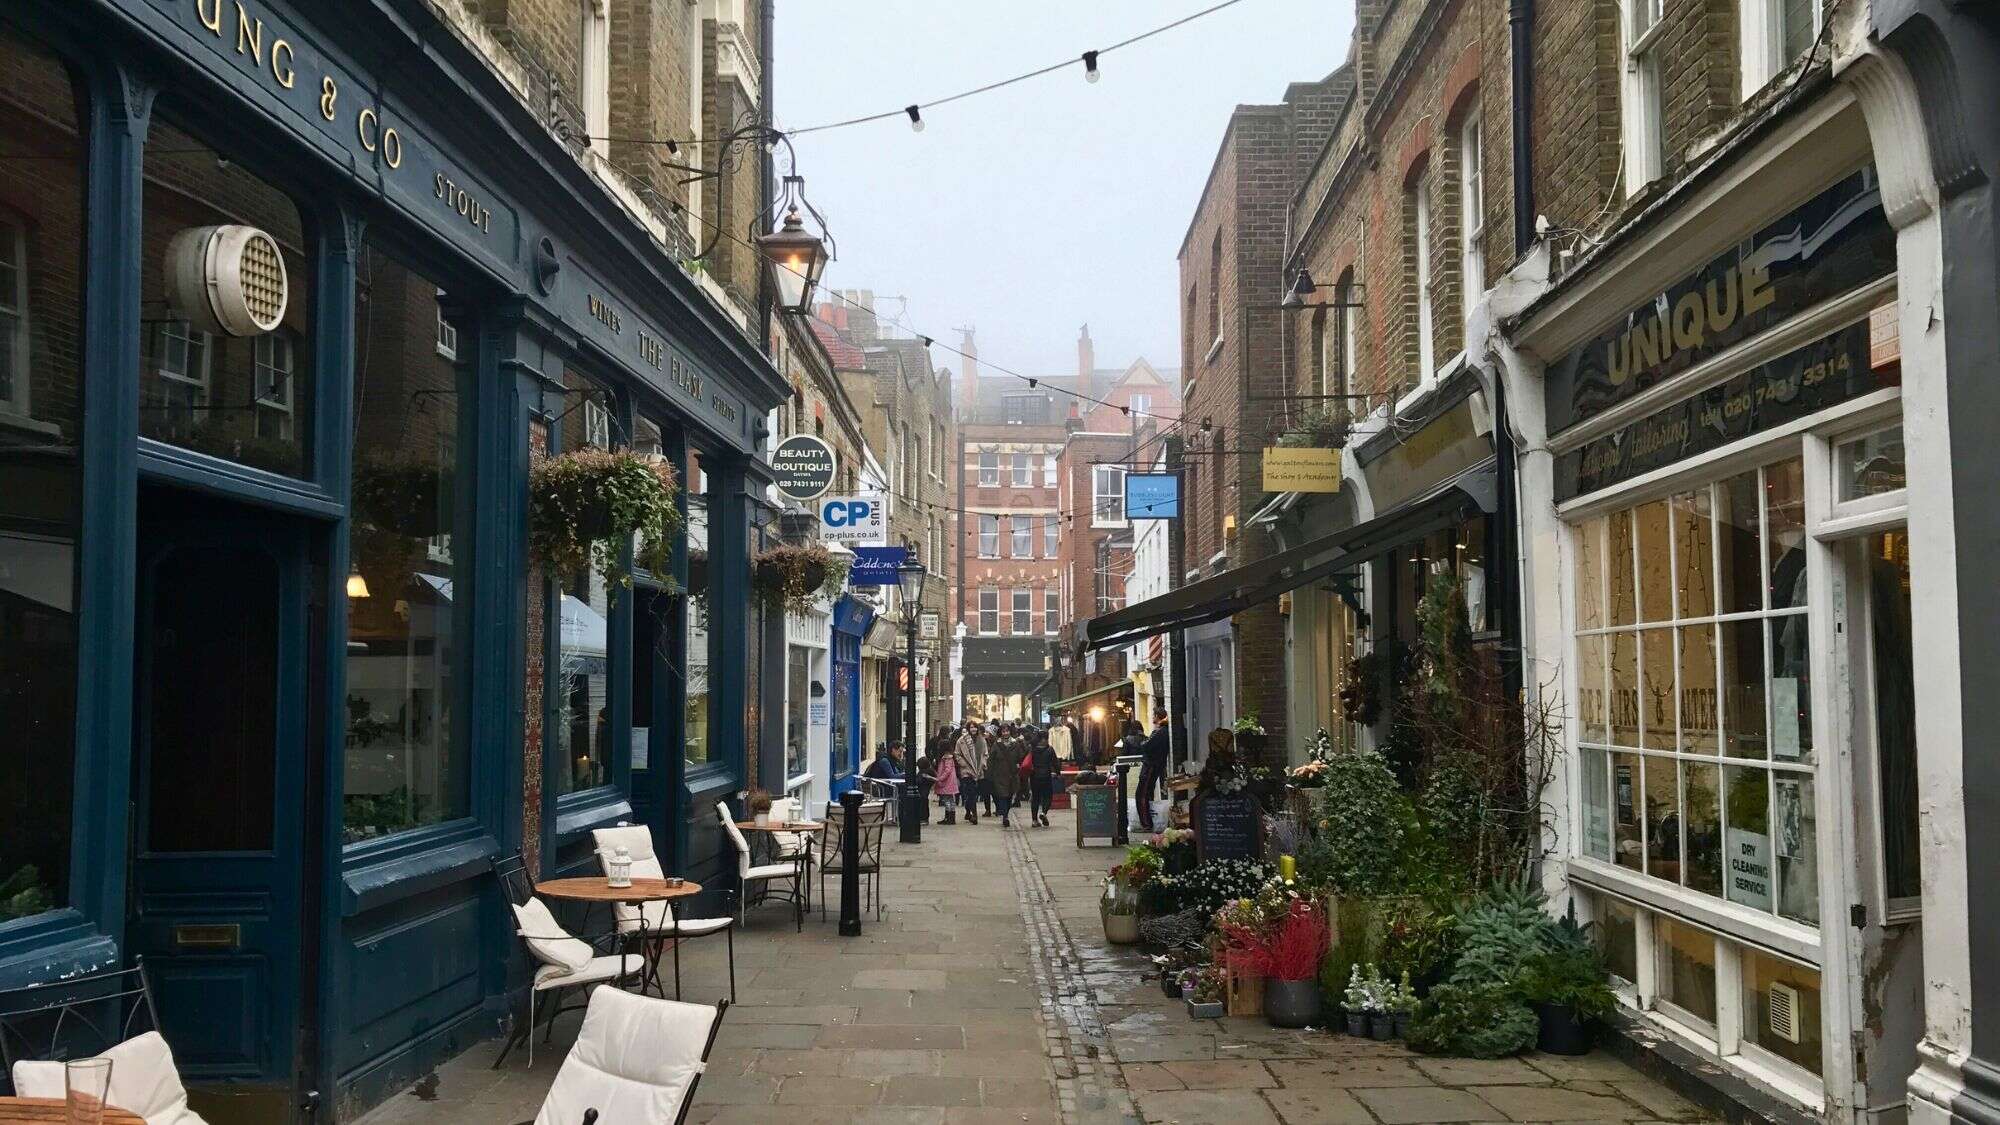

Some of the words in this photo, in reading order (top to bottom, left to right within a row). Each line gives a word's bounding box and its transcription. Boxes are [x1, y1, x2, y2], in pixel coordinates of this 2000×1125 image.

[320, 75, 337, 121] &
[358, 108, 401, 169] CO
[434, 172, 491, 234] STOUT
[1607, 259, 1776, 386] UNIQUE
[588, 293, 622, 335] WINES
[638, 329, 664, 371] THE
[671, 357, 704, 401] FLASK
[1724, 393, 1750, 418] 020
[1803, 353, 1850, 386] 3314
[779, 449, 825, 458] BEAUTY
[774, 463, 832, 472] BOUTIQUE
[823, 501, 870, 528] CP
[871, 501, 880, 526] PLUS
[824, 531, 879, 540] cp-plus.co.uk
[1741, 842, 1756, 858] DRY
[1732, 858, 1769, 877] CLEANING
[1735, 876, 1767, 897] SERVICE
